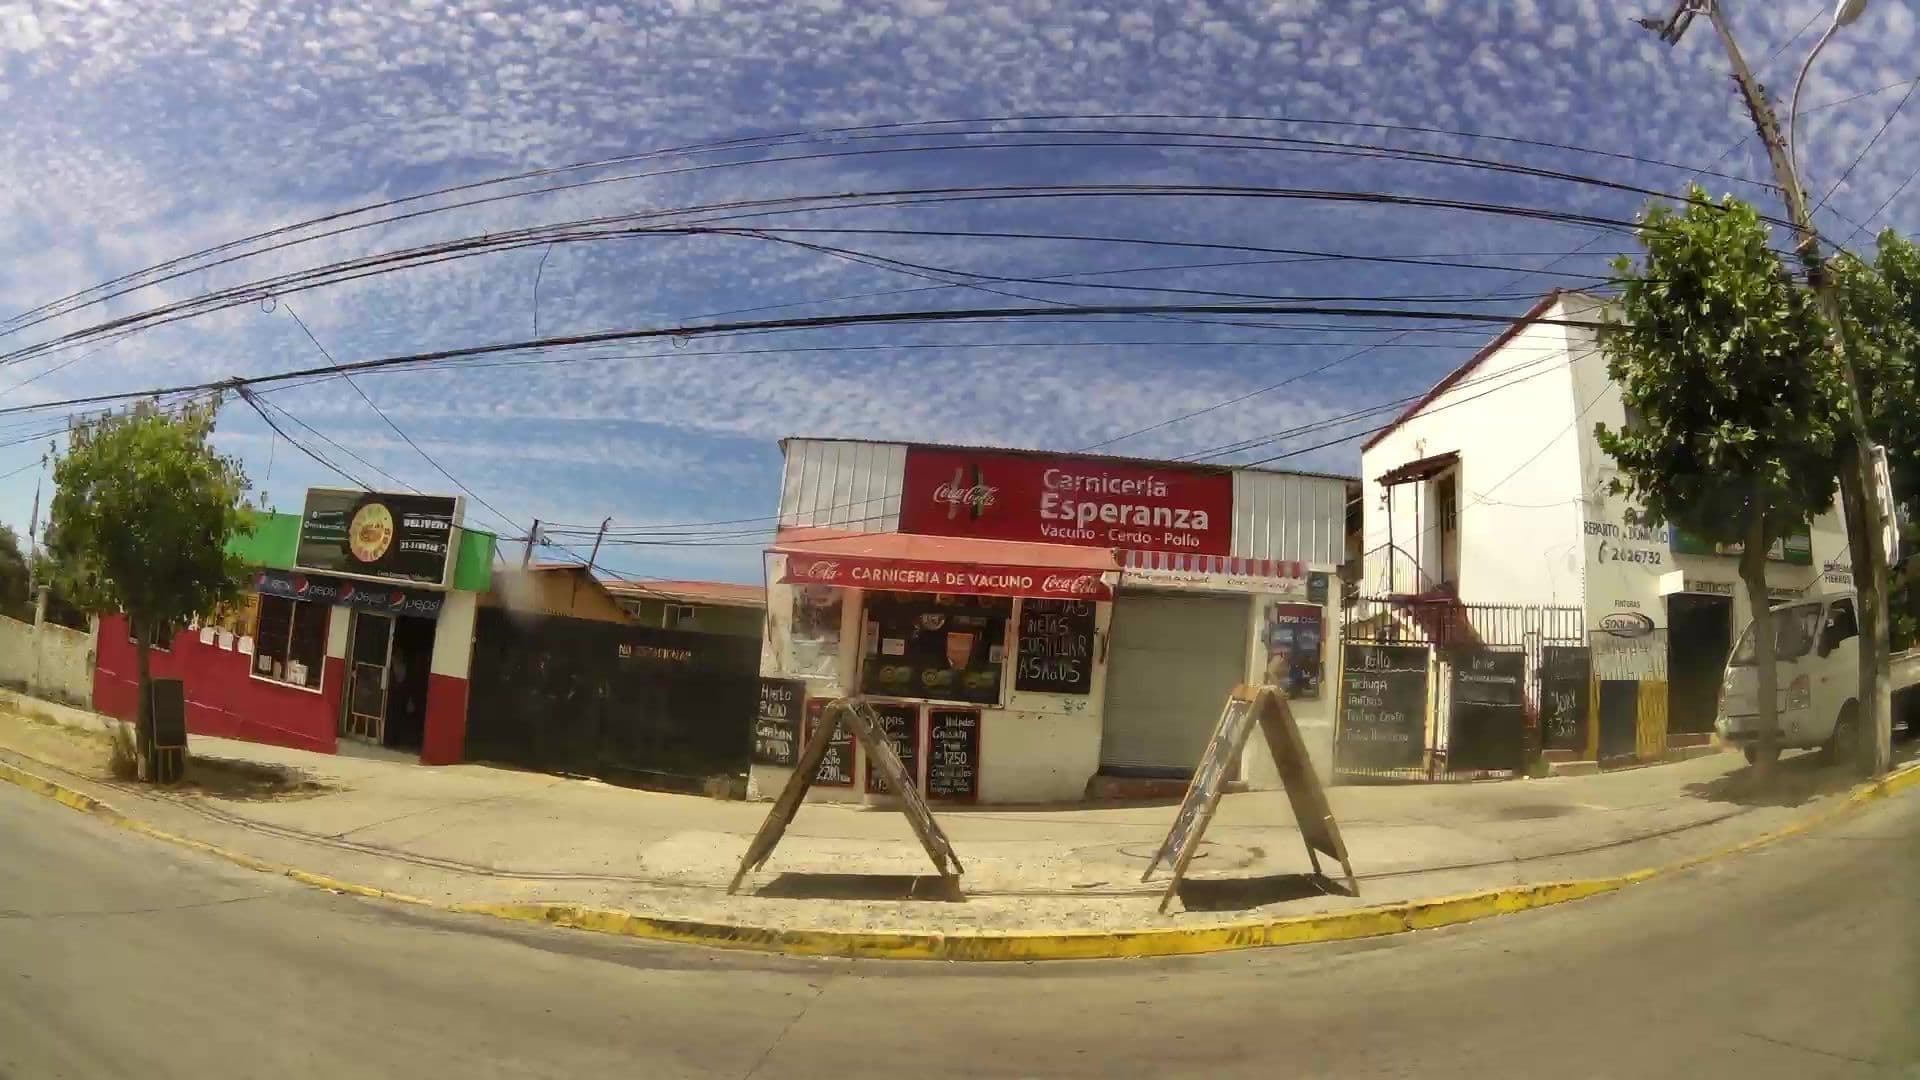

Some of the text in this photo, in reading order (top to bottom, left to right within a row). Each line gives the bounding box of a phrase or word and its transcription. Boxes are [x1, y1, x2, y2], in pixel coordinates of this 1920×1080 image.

[1043, 468, 1168, 497] Carnicería
[1040, 492, 1209, 530] Esperanza
[1041, 523, 1096, 540] Vacuno
[1164, 532, 1200, 547] Pollo
[851, 566, 1033, 590] CARNICERIA DE VACUNO
[308, 585, 337, 597] pepsi
[404, 600, 441, 614] pepsi
